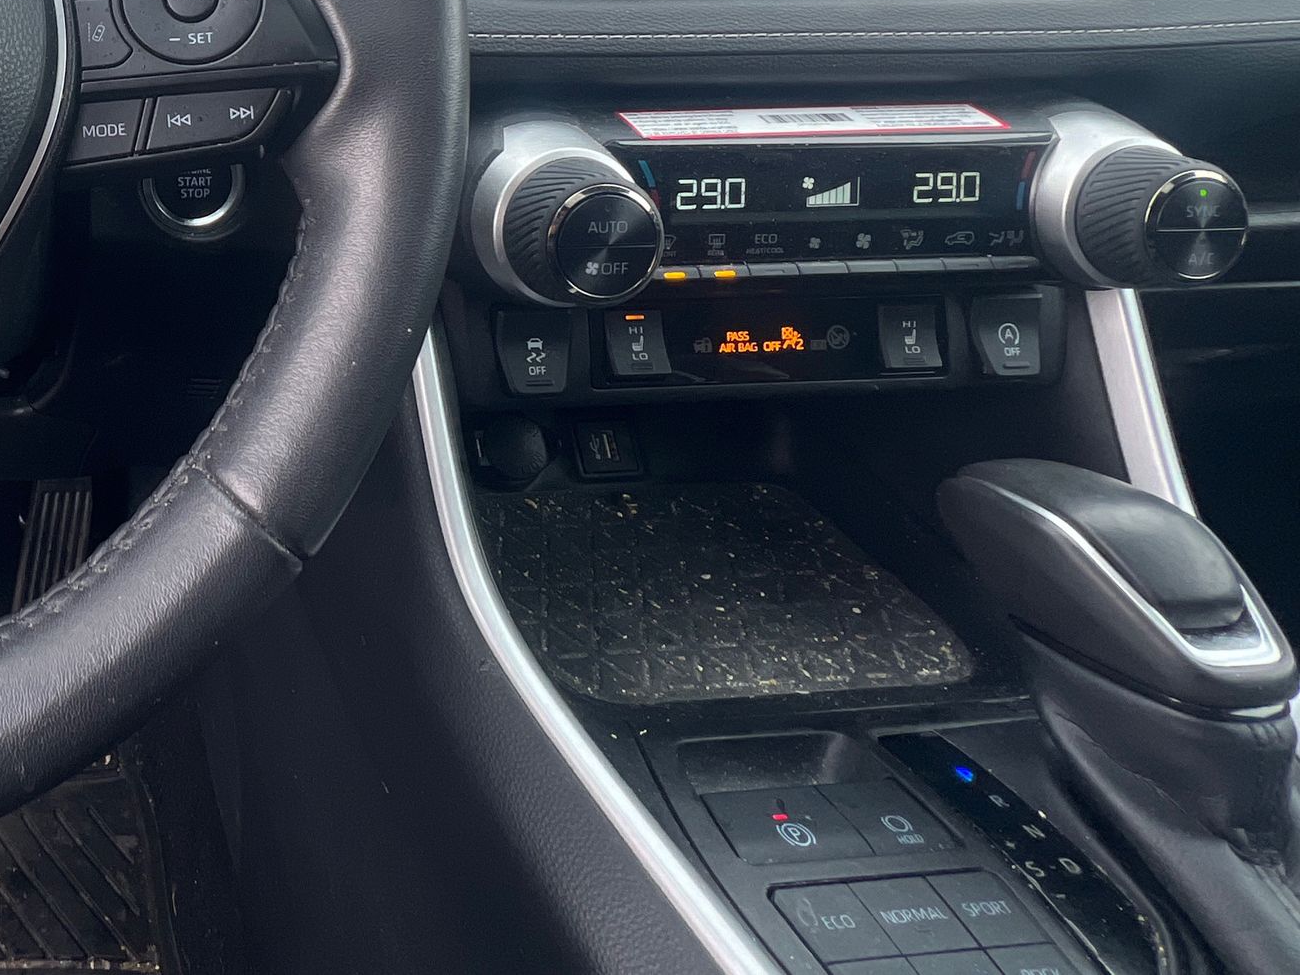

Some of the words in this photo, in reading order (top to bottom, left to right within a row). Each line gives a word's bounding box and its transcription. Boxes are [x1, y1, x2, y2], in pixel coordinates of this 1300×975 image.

[187, 31, 213, 45] SET
[82, 123, 127, 139] MODE
[177, 176, 213, 187] START
[912, 171, 981, 204] 29.0
[180, 188, 211, 199] STOP
[675, 177, 747, 211] 29.0
[1186, 205, 1221, 218] SYNC
[587, 220, 629, 234] AUTO
[754, 233, 778, 245] ECO
[1187, 252, 1215, 265] A/C
[601, 262, 629, 275] OFF
[628, 326, 644, 335] HI
[902, 320, 917, 328] HI
[726, 330, 751, 342] PASS
[718, 342, 736, 354] AIR
[737, 341, 759, 353] BAG
[762, 340, 782, 352] OFF
[904, 345, 921, 354] LO
[1004, 347, 1021, 357] OFF
[631, 352, 649, 361] LO
[528, 365, 547, 376] OFF
[1021, 824, 1047, 839] N
[896, 833, 925, 845] HOLD
[1024, 860, 1045, 877] S
[1057, 857, 1083, 874] D
[879, 905, 949, 926] NORMAL
[960, 900, 1012, 918] SPORT
[820, 913, 856, 930] ECO
